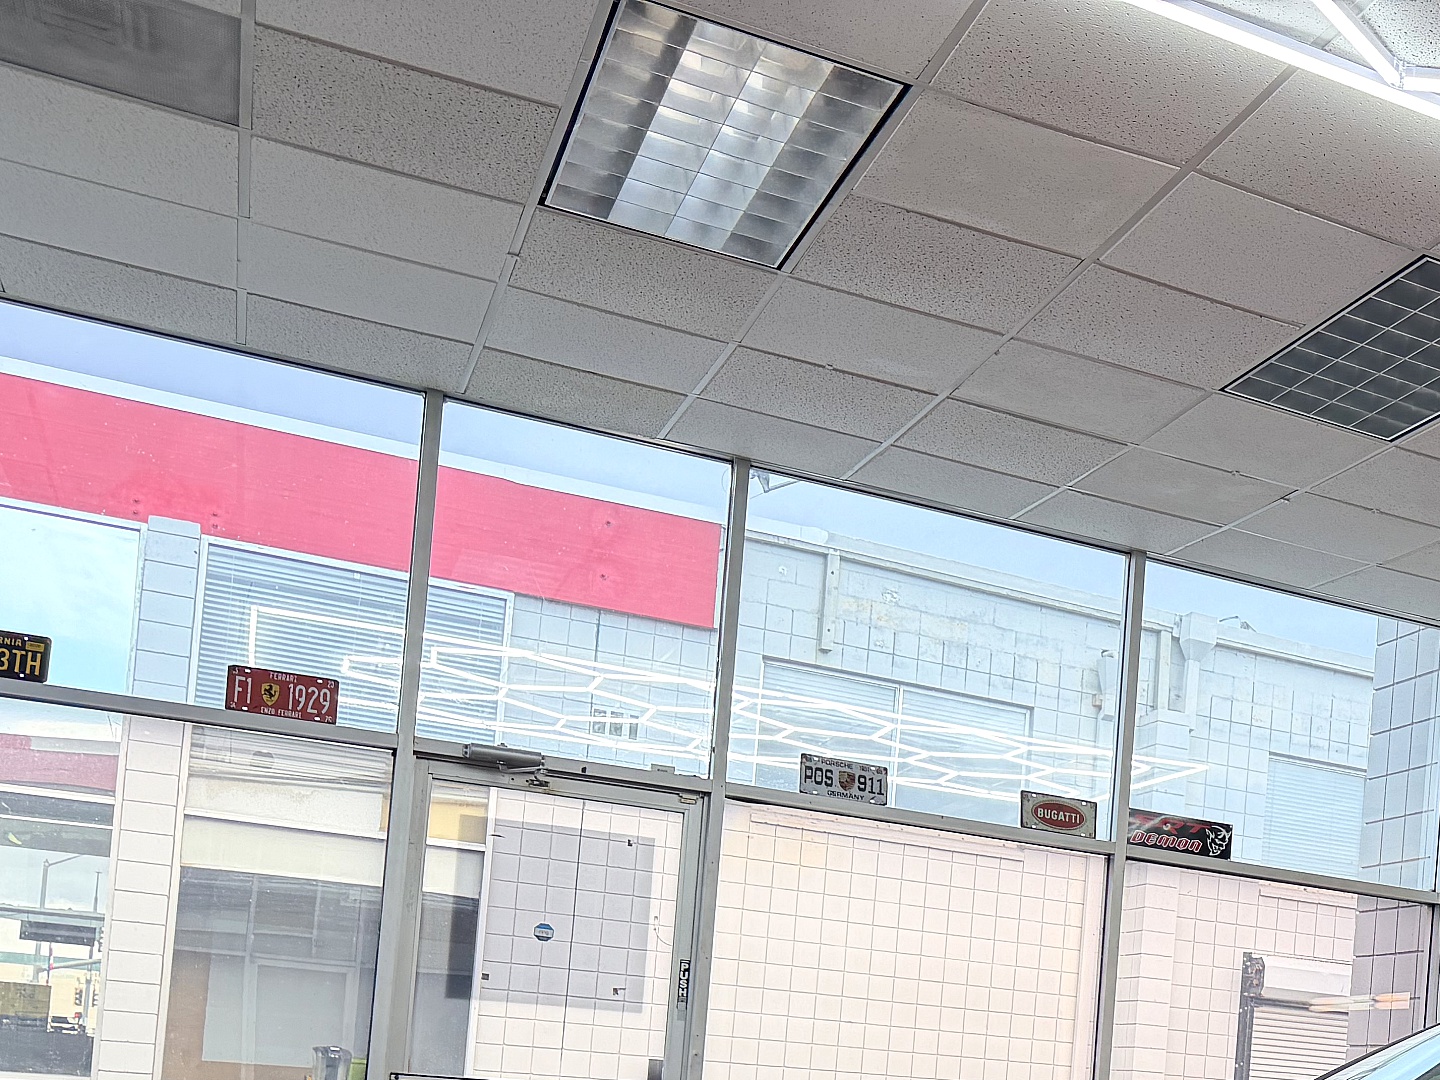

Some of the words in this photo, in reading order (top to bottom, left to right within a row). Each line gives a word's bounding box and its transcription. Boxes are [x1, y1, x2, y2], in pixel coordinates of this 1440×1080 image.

[270, 672, 298, 683] FERRARI
[233, 675, 252, 704] F1
[288, 683, 331, 714] 1929
[260, 706, 276, 716] ENZO
[278, 708, 302, 719] FERRARI
[821, 758, 853, 770] PORSCHE
[857, 774, 885, 796] 911
[826, 790, 865, 801] GERMANY
[1037, 807, 1080, 824] BUGATTI
[1130, 829, 1203, 853] DEMON
[678, 962, 690, 997] PUSH
